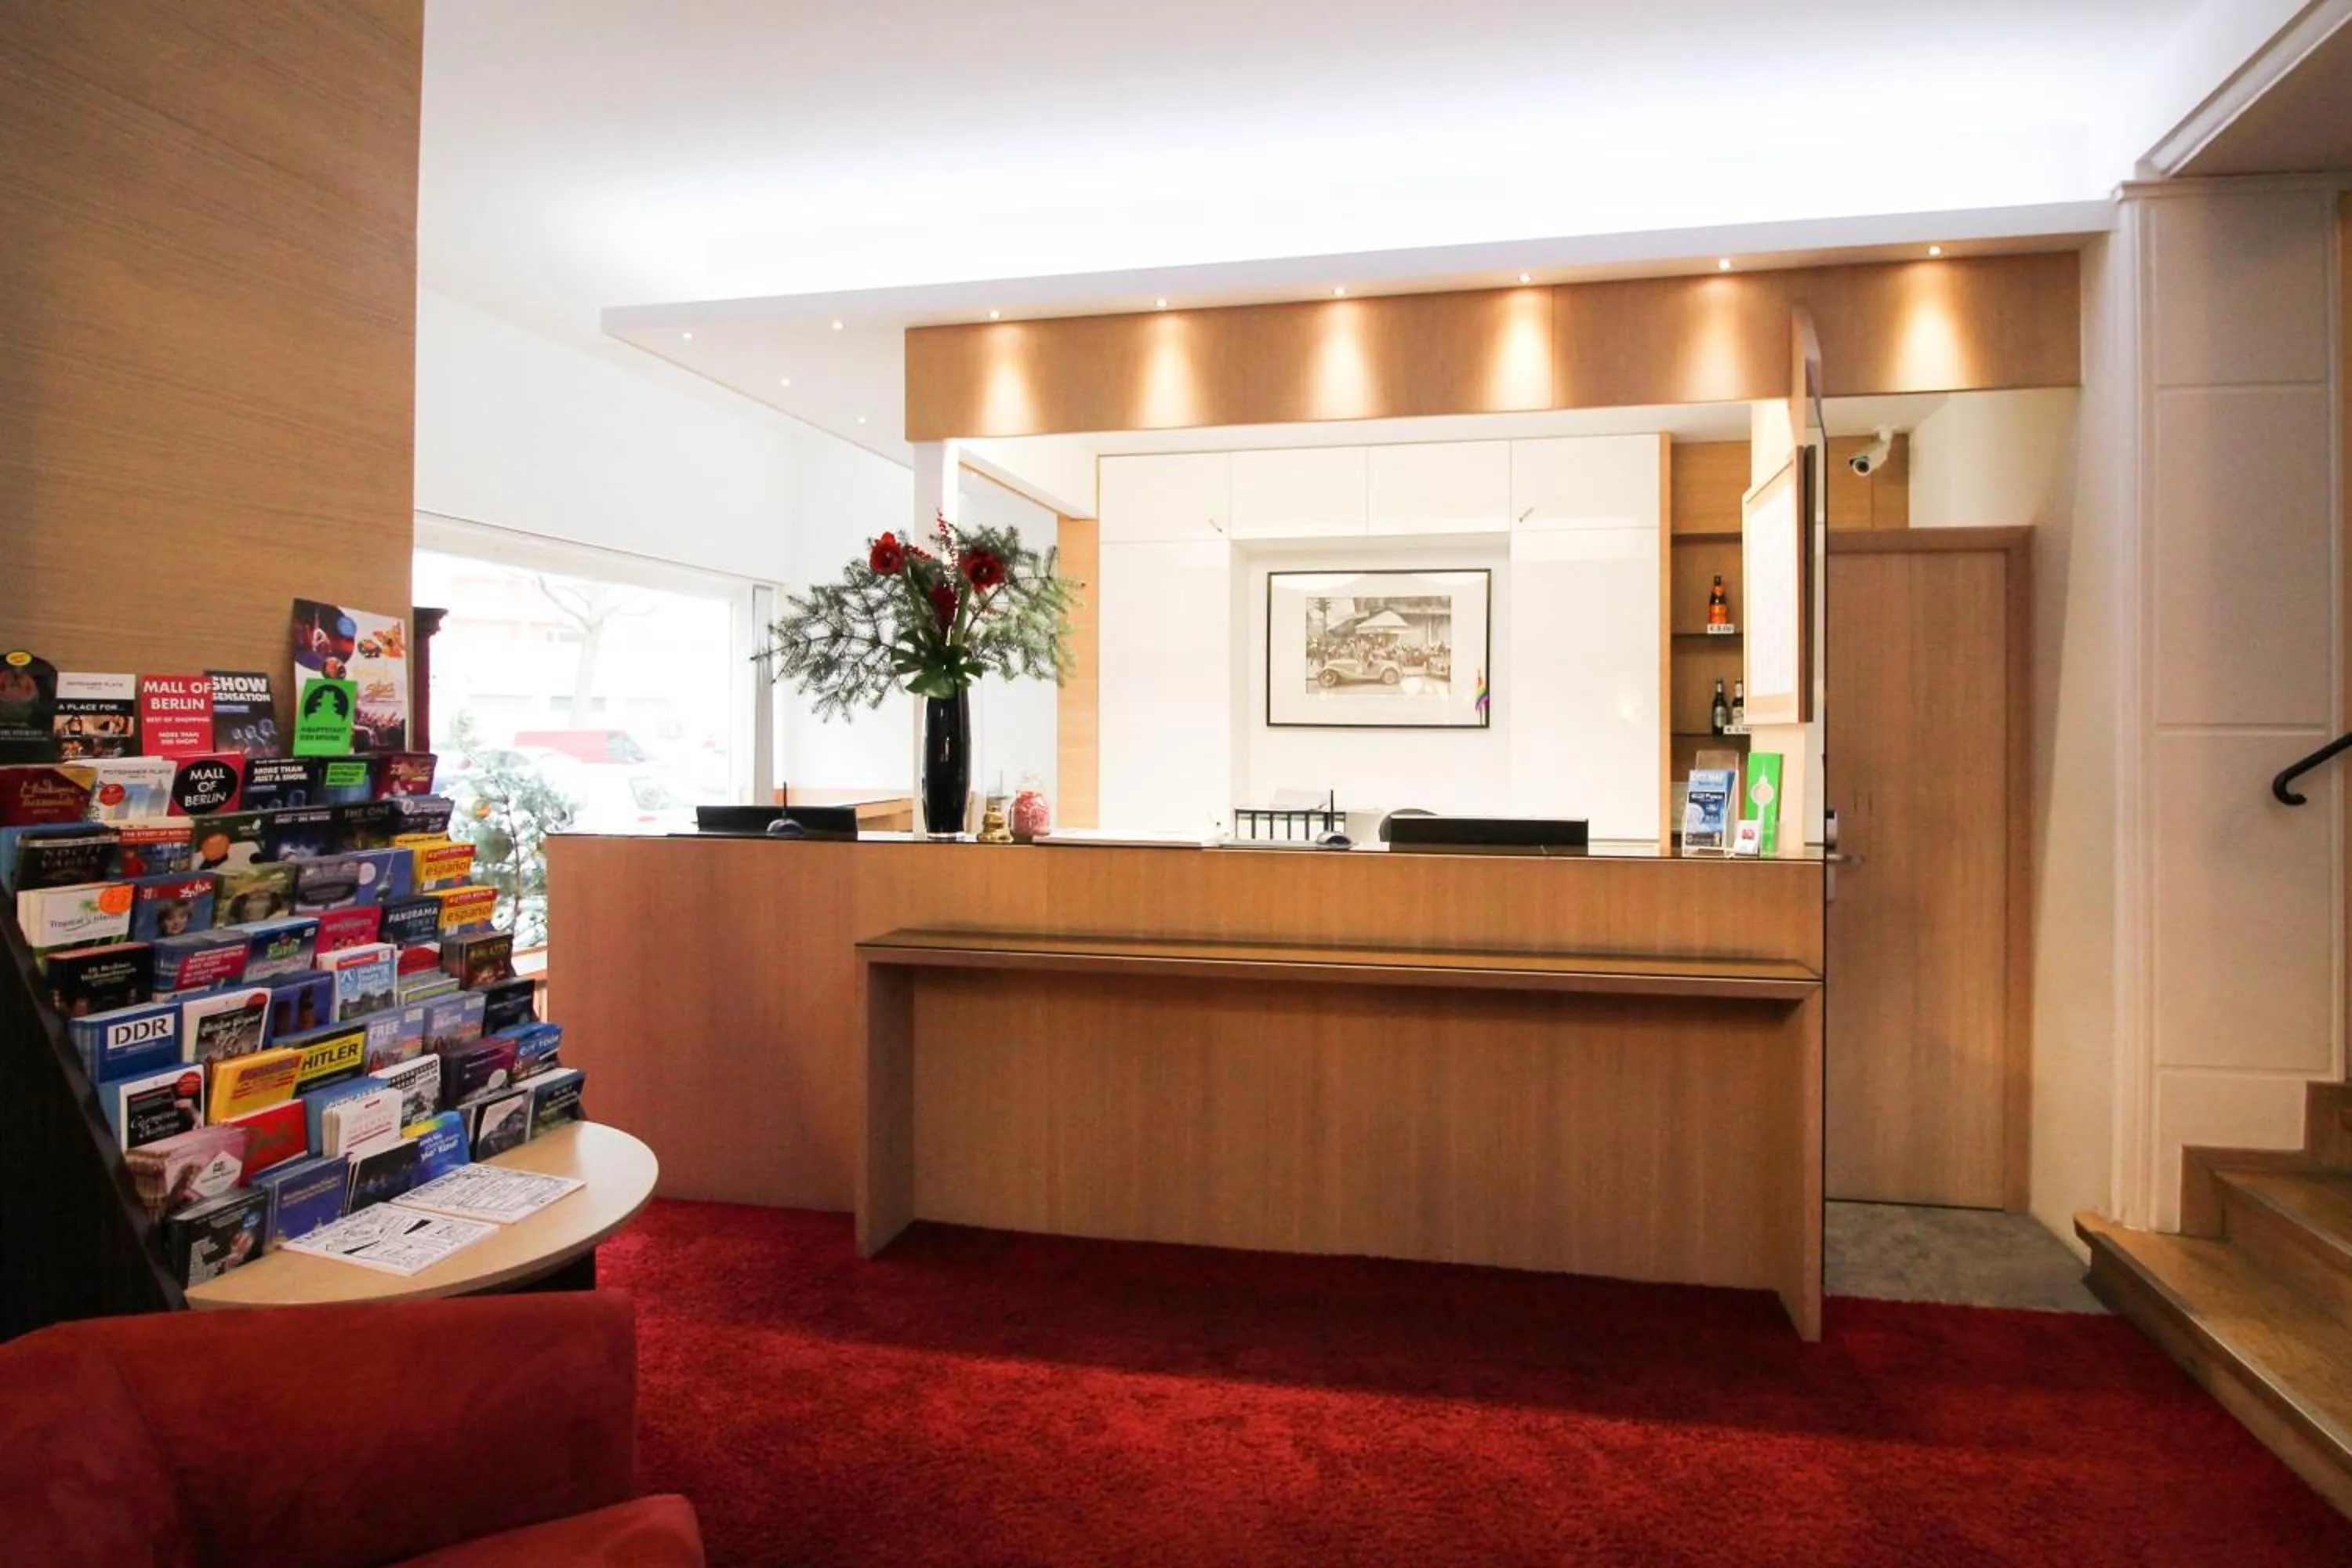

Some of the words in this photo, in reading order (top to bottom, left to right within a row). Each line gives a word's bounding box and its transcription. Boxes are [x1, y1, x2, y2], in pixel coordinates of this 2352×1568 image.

[143, 681, 186, 694] MALL
[190, 681, 213, 694] OF
[212, 677, 267, 692] SHOW
[150, 697, 205, 710] BERLIN
[212, 692, 270, 702] SENSATION
[190, 768, 226, 781] MALL
[198, 782, 218, 793] OF
[184, 792, 227, 808] BERLIN
[345, 808, 364, 818] THE
[388, 906, 438, 924] PANORAMA
[114, 1018, 168, 1046] DDR
[368, 1020, 400, 1039] FREE
[301, 1043, 358, 1071] HITLER
